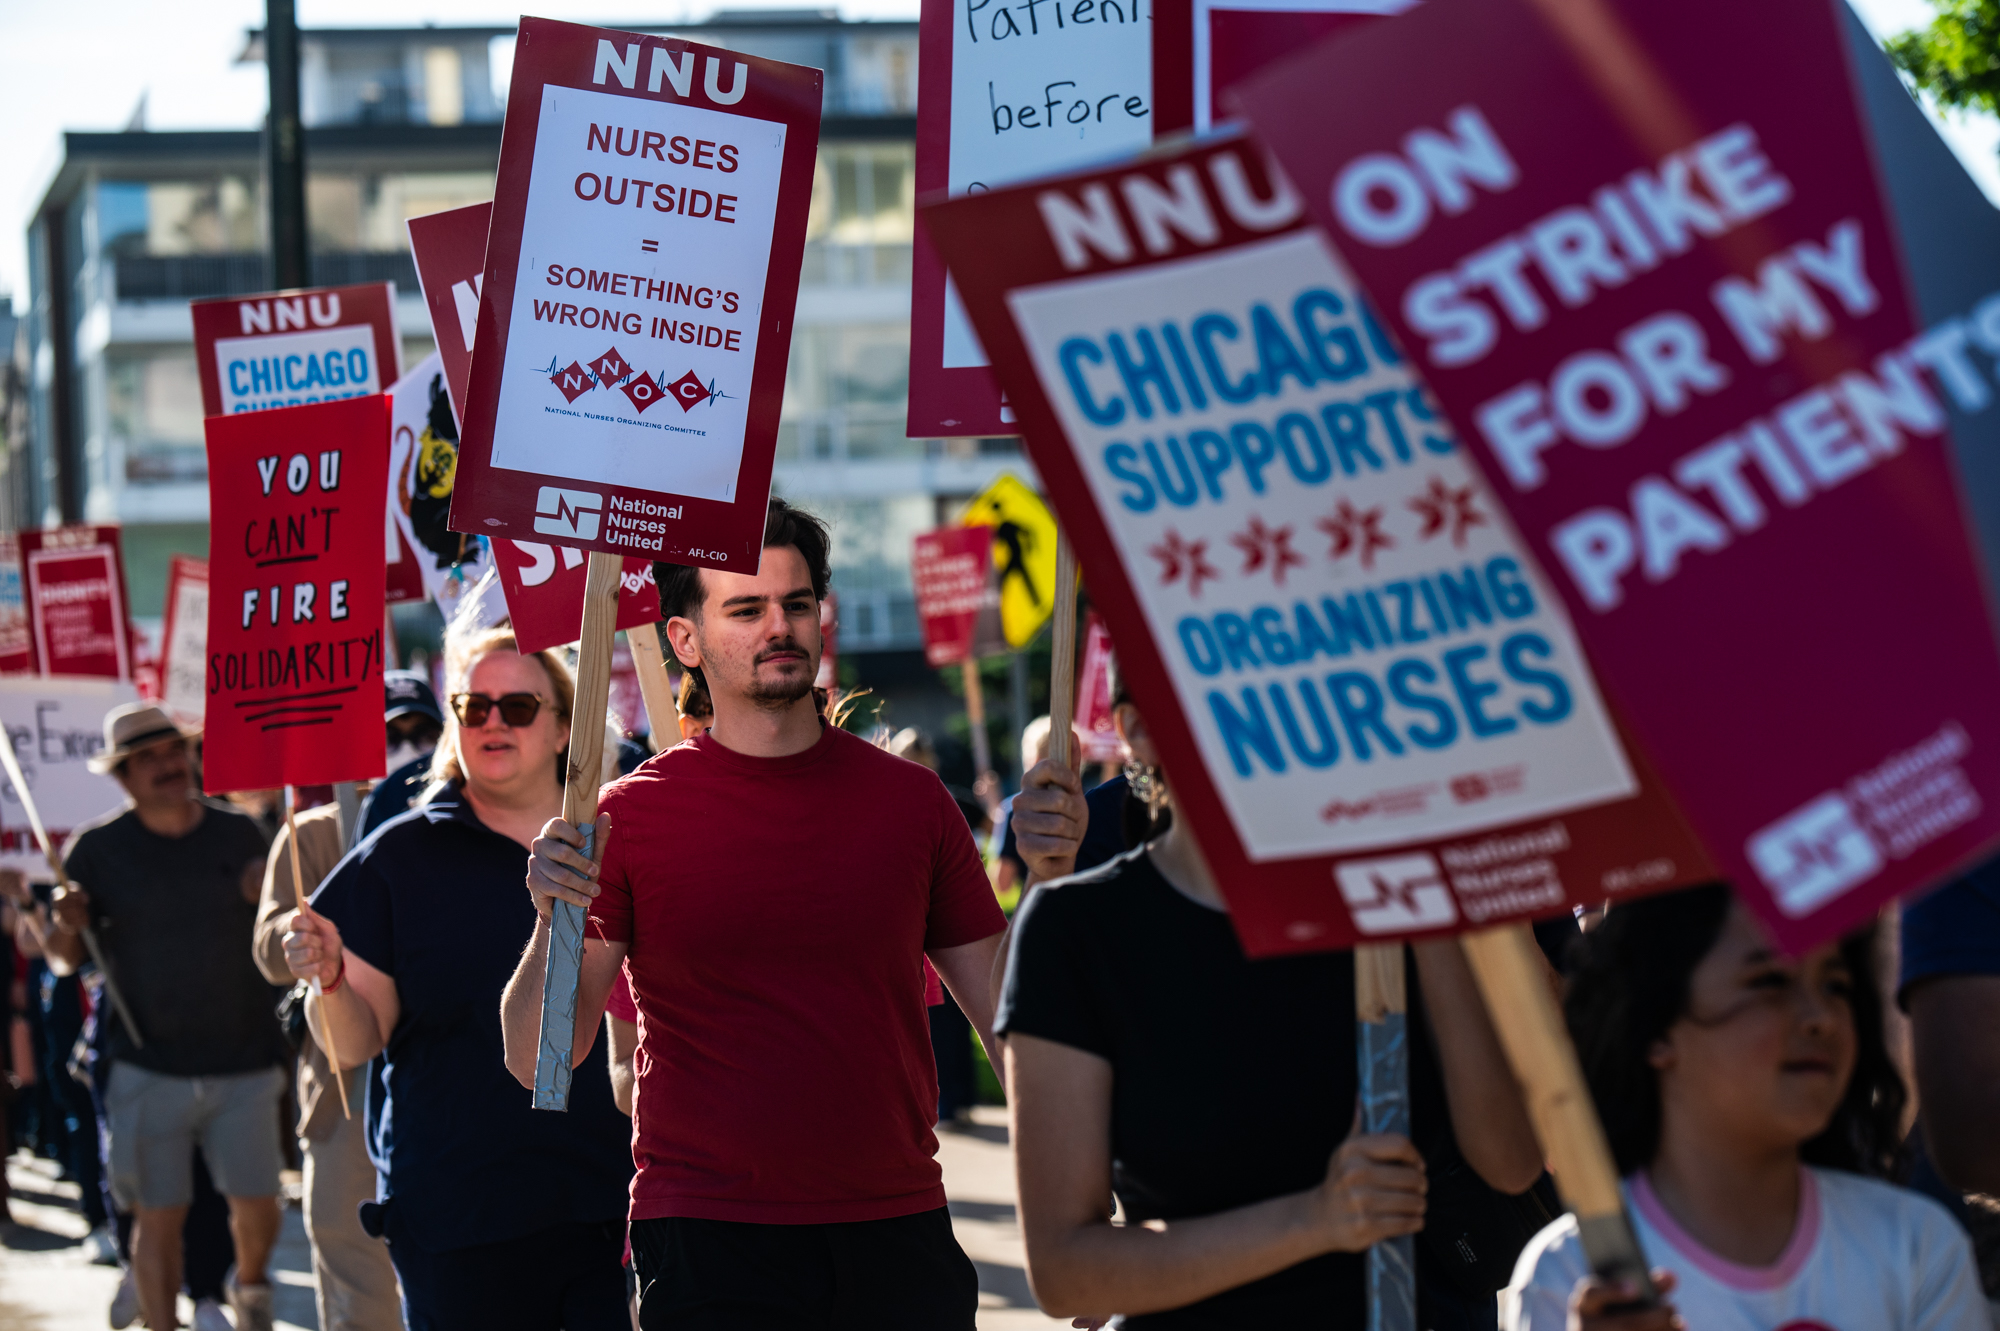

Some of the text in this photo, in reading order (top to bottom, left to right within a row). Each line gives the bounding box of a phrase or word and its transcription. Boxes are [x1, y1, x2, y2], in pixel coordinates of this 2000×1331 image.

[592, 39, 748, 105] NNU
[989, 81, 1149, 135] before
[587, 123, 740, 173] NURSES
[574, 172, 738, 224] OUTSIDE
[1333, 103, 1520, 247] ON
[1038, 151, 1304, 271] NNU
[1404, 123, 1792, 368] STRIKE
[240, 293, 341, 335] NNU
[546, 264, 740, 314] SOMETHING'S
[533, 299, 742, 352] WRONG INSIDE
[228, 348, 369, 397] CHICAGO
[1476, 218, 1880, 492] FOR MY
[256, 449, 342, 497] YOU
[245, 507, 340, 559] CAN'T
[608, 513, 666, 534] Nurses
[610, 496, 683, 520] National
[605, 529, 664, 551] United
[688, 548, 728, 561] AFL-CIO
[241, 579, 350, 629] FIRE
[1177, 555, 1536, 678] ORGANIZING
[210, 629, 382, 694] SOLIDARITY!
[1206, 631, 1575, 779] NURSES
